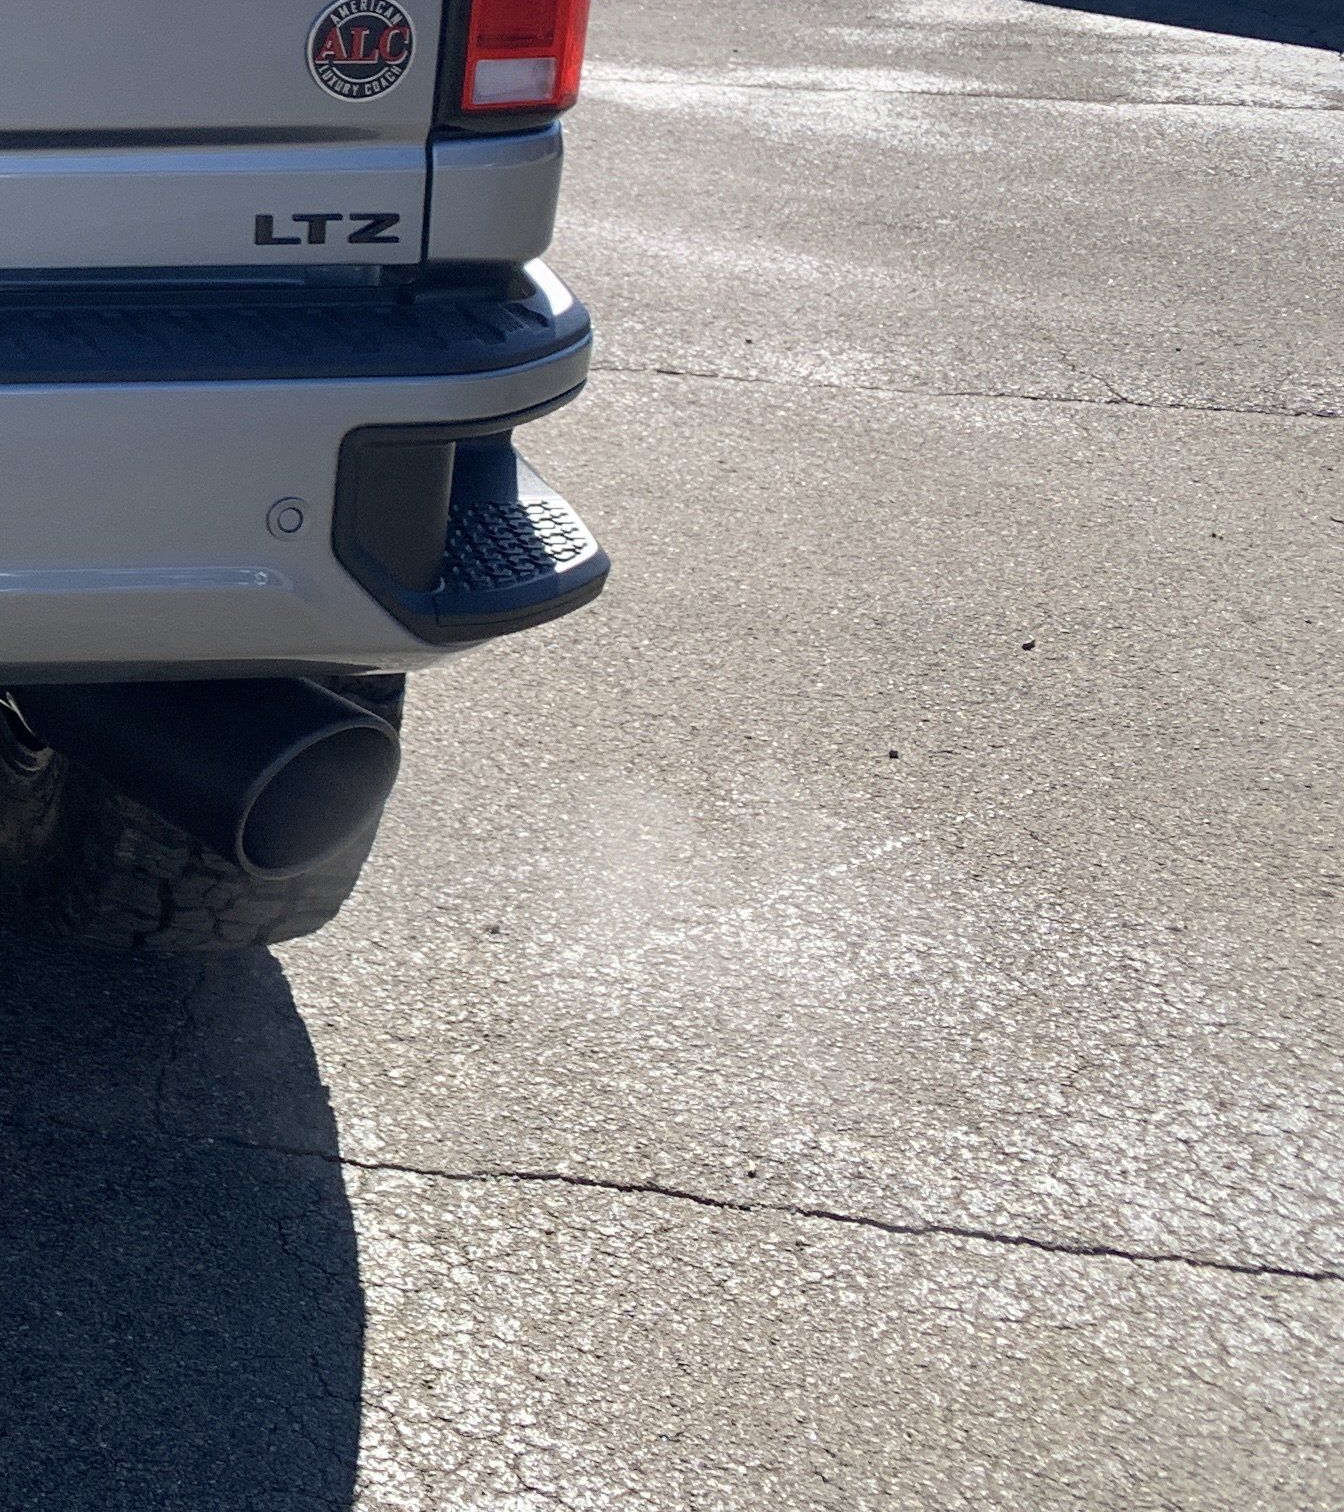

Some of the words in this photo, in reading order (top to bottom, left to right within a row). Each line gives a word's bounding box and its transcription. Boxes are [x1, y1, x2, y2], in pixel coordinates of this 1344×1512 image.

[314, 24, 410, 64] ALC
[318, 65, 360, 96] LUXURY
[364, 65, 403, 96] COACH
[254, 212, 400, 245] LTZ
